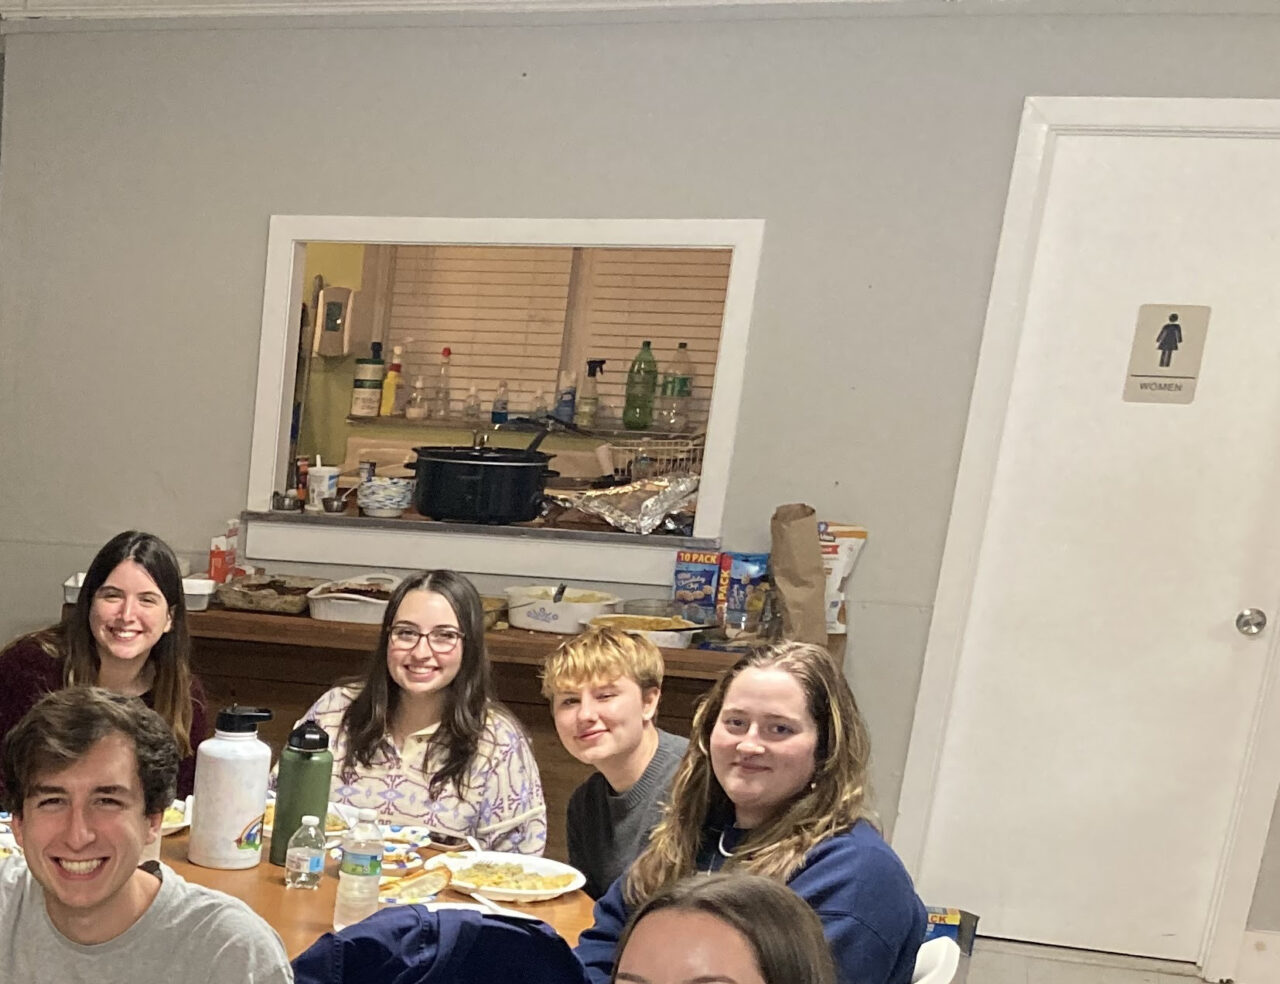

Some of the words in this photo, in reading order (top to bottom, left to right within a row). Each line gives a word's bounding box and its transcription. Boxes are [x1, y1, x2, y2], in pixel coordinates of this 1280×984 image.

[1140, 382, 1183, 392] WOMEN
[680, 552, 691, 562] 10
[692, 553, 717, 564] PACK
[718, 570, 730, 600] PACK
[930, 914, 947, 924] CK
